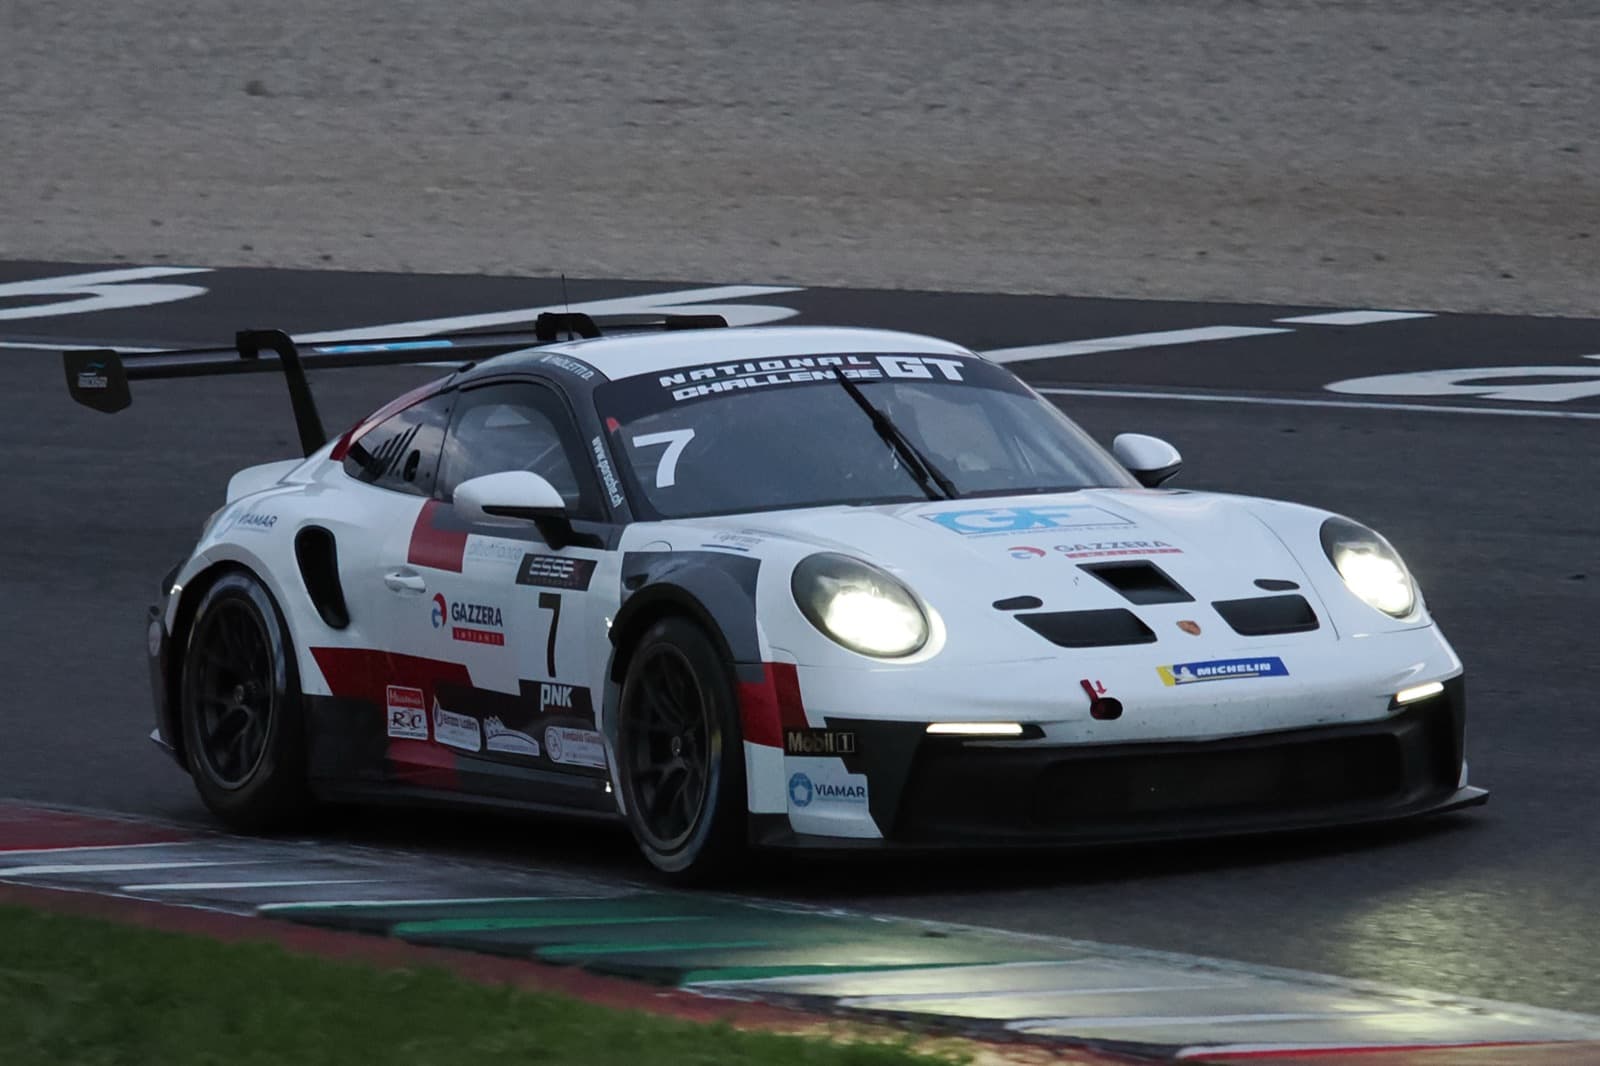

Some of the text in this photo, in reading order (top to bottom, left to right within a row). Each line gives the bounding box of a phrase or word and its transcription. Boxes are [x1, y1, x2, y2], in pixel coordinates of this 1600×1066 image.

[659, 356, 874, 387] NATIONAL
[876, 356, 964, 382] GT
[672, 368, 884, 401] CHALLENGE
[632, 428, 695, 488] 7
[592, 436, 624, 509] www.porsche.ch
[1053, 540, 1173, 552] GAZZERA
[451, 602, 503, 627] GAZZERA
[538, 592, 562, 678] 7
[1197, 662, 1271, 676] MICHELIN
[788, 732, 834, 752] Mobil
[814, 784, 865, 798] VIAMAR
